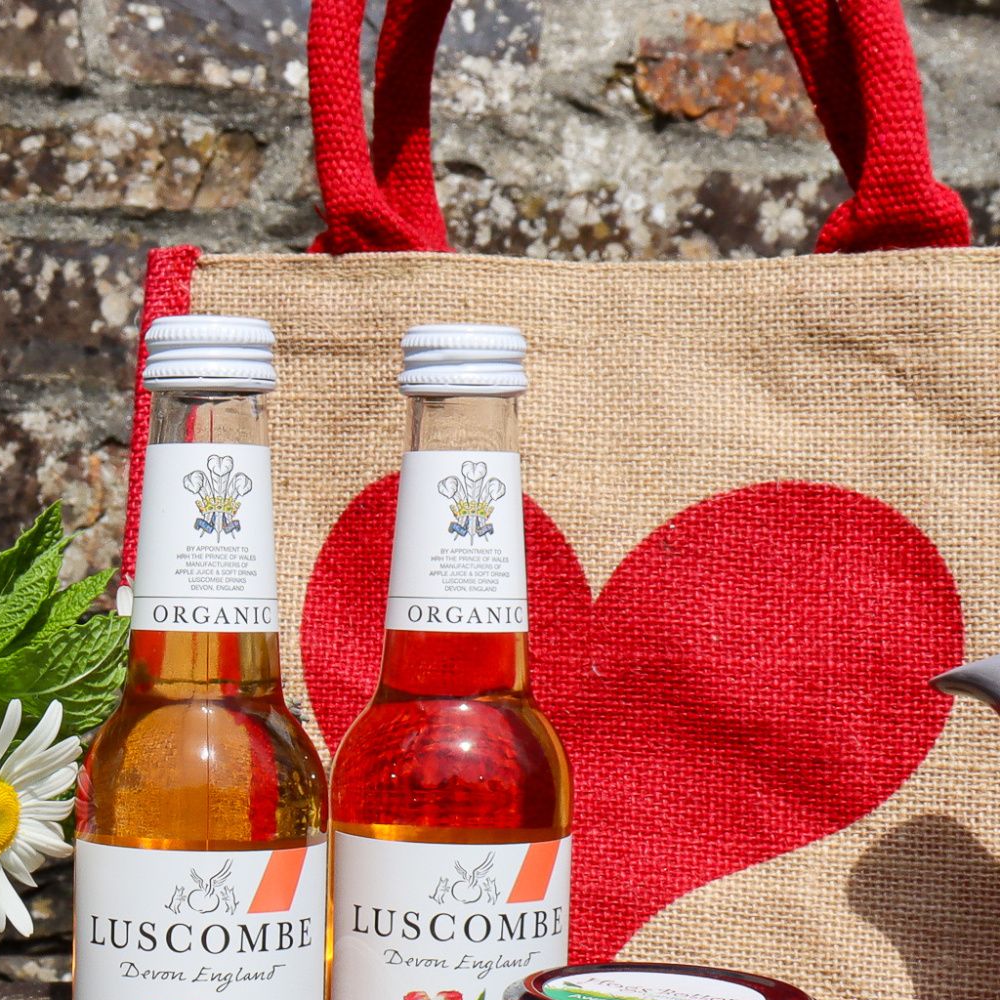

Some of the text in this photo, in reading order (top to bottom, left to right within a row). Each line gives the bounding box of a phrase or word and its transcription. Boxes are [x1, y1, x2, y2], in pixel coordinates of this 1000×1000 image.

[450, 548, 494, 556] APPOINTMENT
[153, 604, 271, 625] ORGANIC
[407, 604, 523, 624] ORGANIC
[90, 914, 312, 955] LUSCOMBE
[352, 904, 563, 943] LUSCOMBE
[119, 961, 286, 993] Devon England
[383, 948, 541, 980] Devon England
